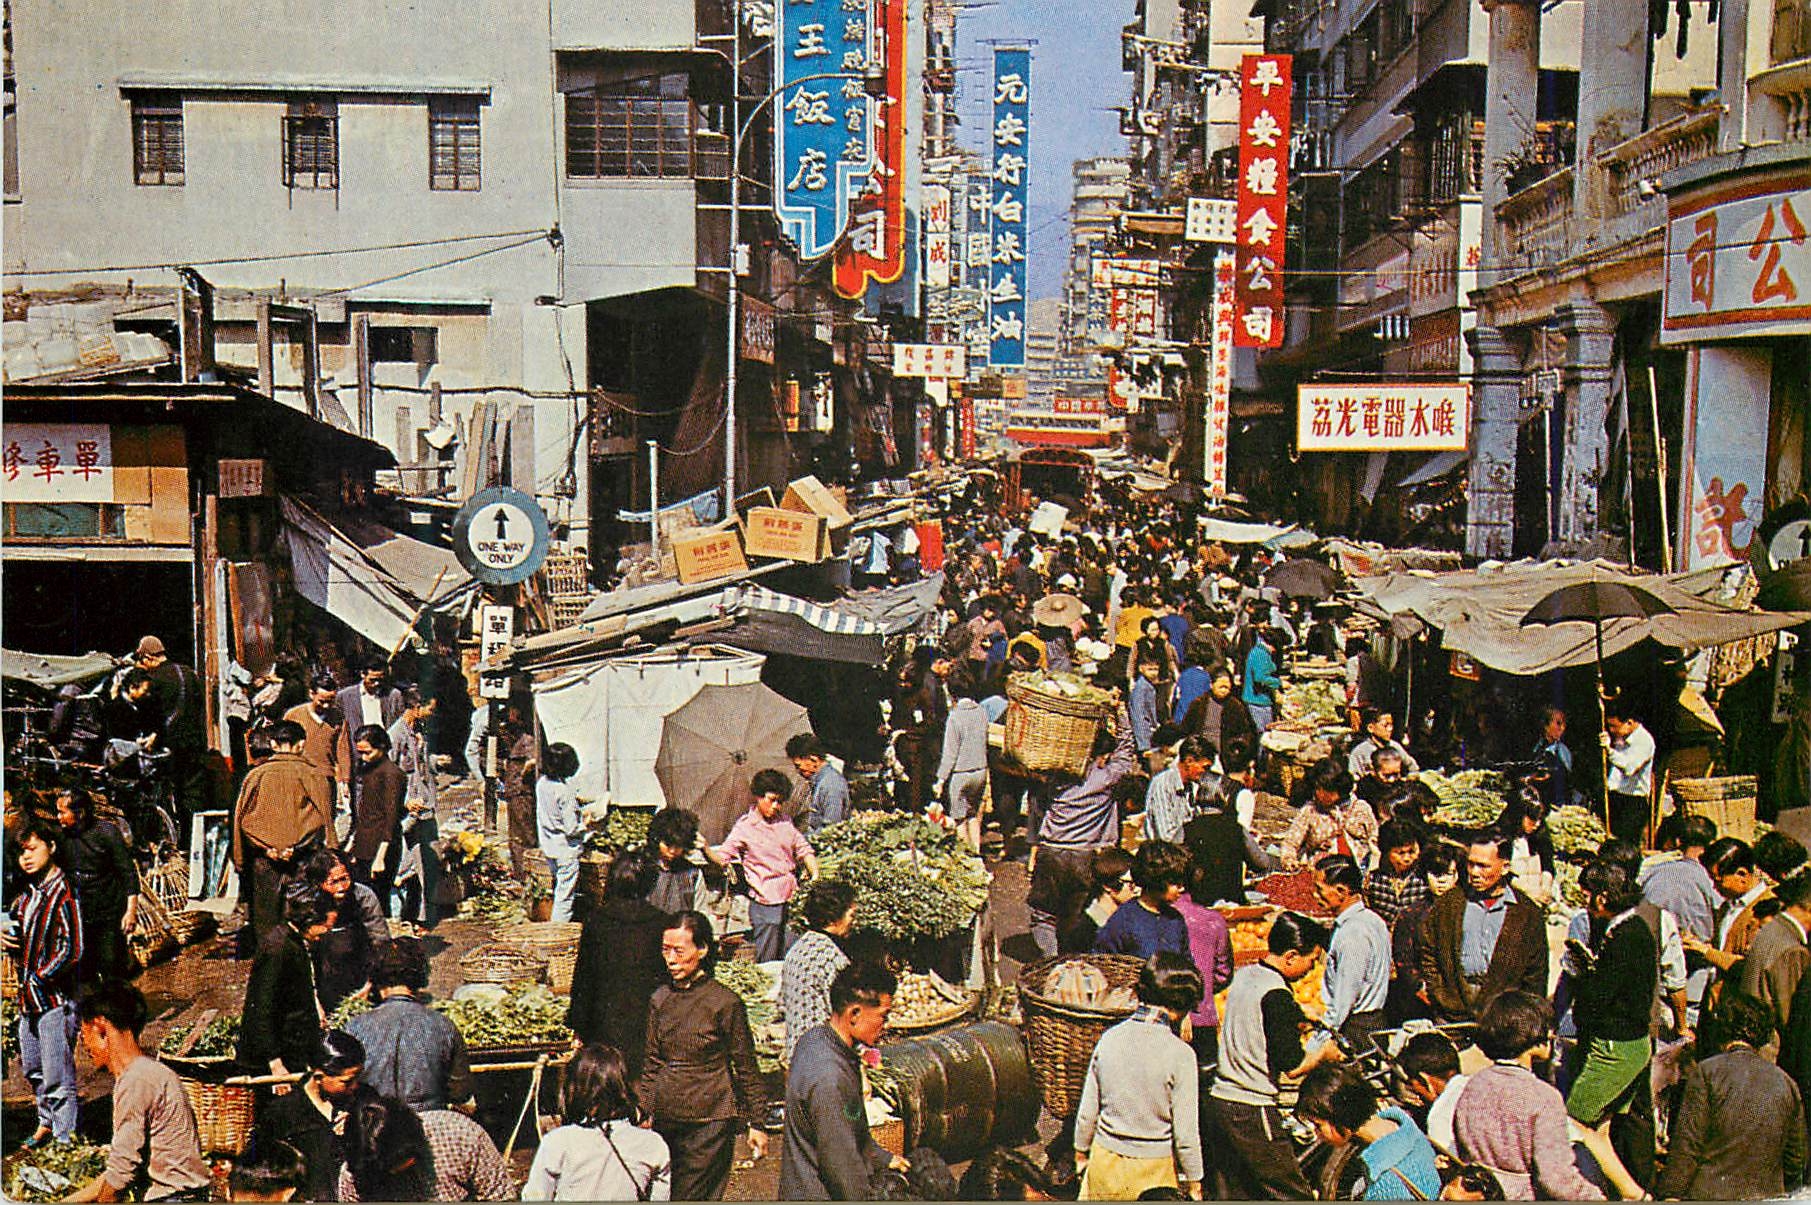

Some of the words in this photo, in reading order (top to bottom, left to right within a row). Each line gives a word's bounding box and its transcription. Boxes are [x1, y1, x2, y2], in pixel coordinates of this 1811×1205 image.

[785, 0, 837, 191] 王飯店
[991, 73, 1028, 342] 元安行白米生油
[478, 542, 499, 551] ONE
[503, 543, 525, 552] WAY
[489, 553, 515, 563] ONLY
